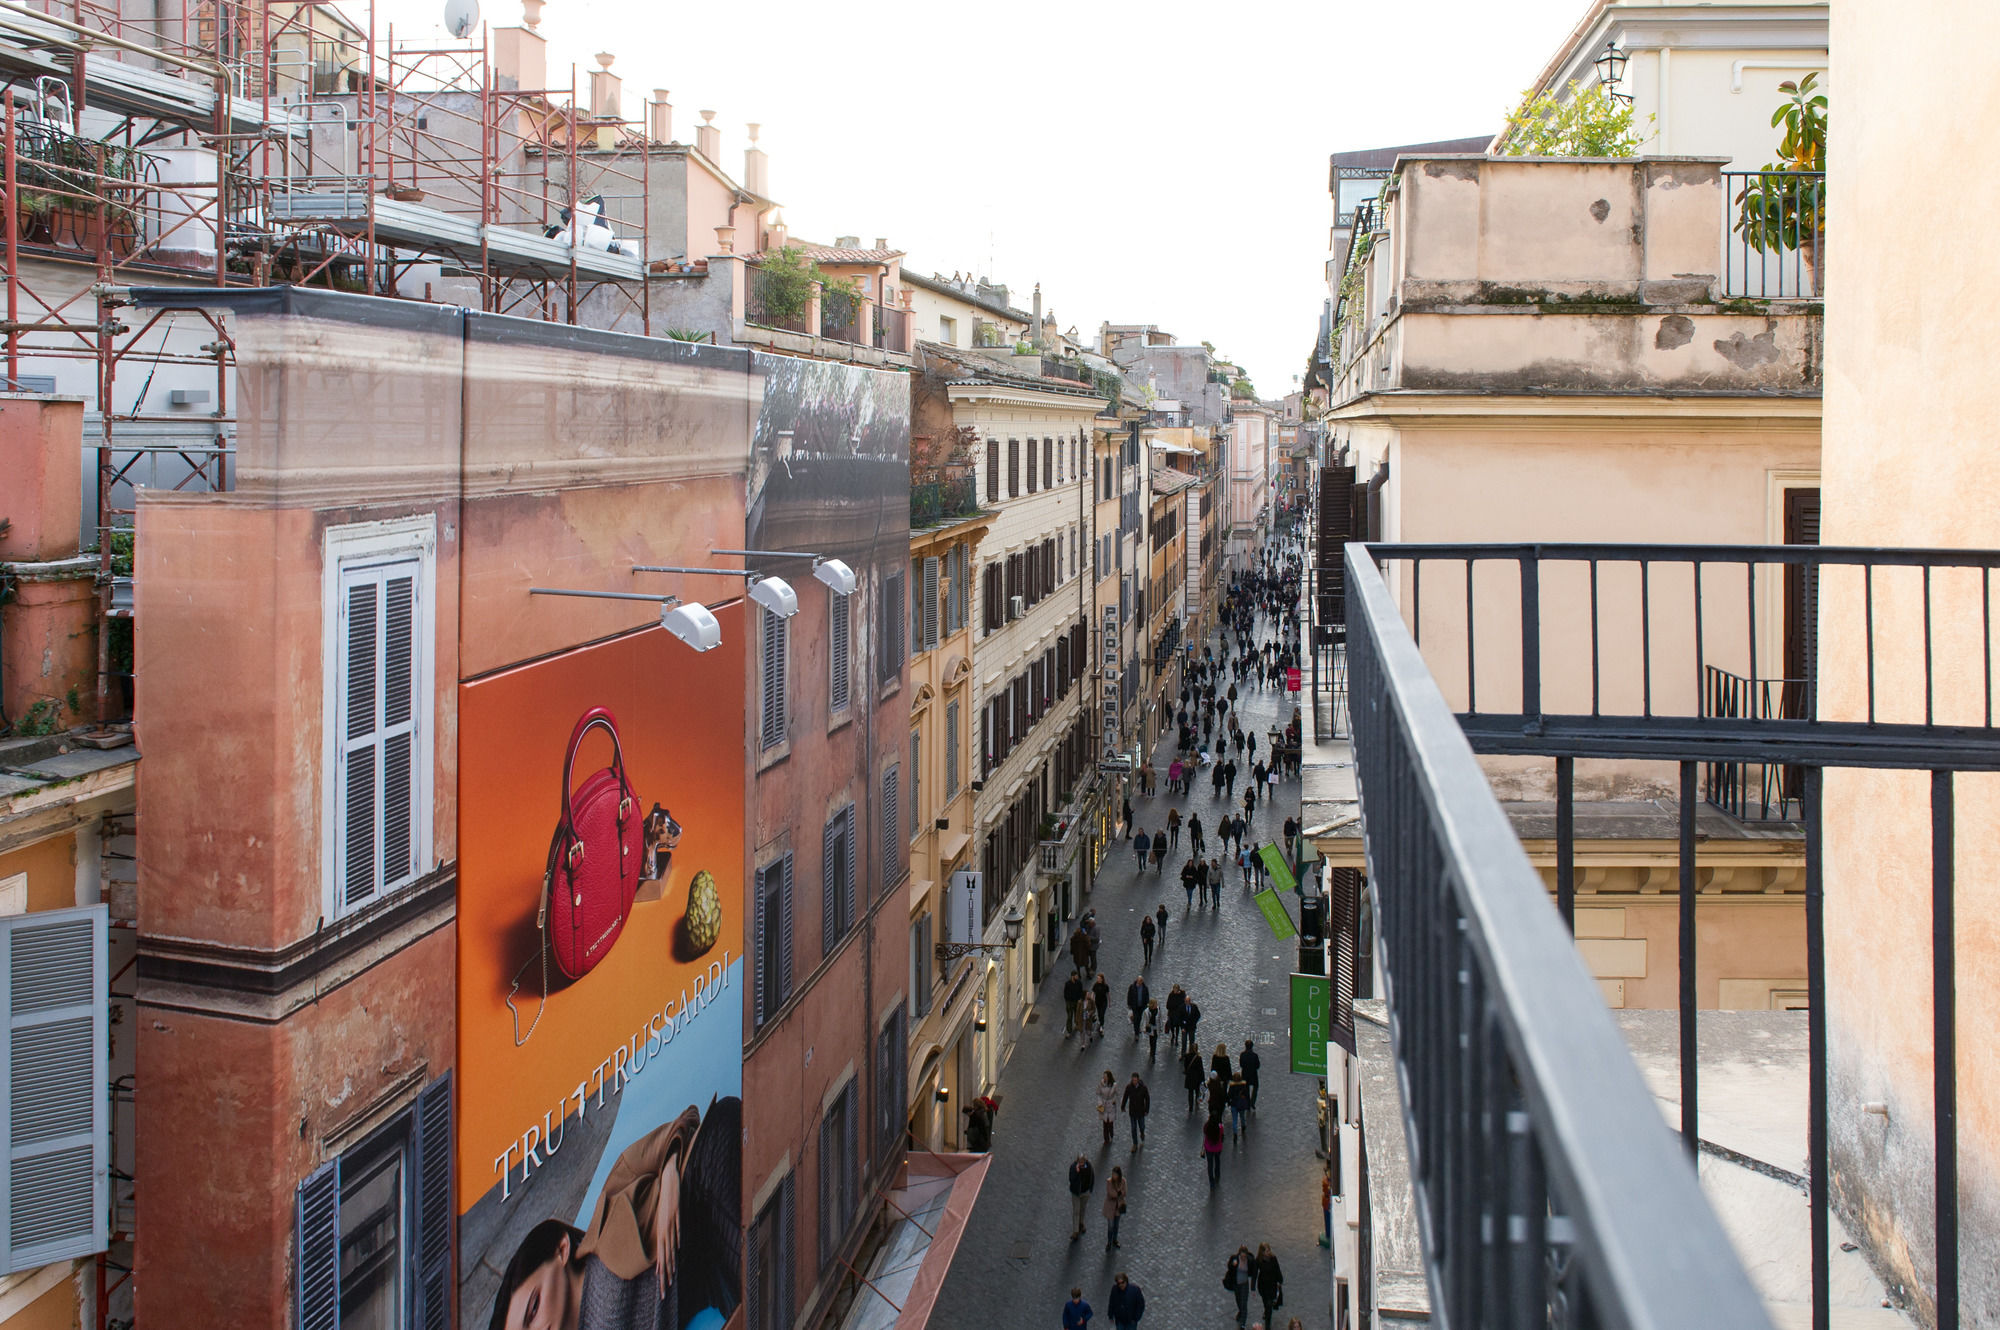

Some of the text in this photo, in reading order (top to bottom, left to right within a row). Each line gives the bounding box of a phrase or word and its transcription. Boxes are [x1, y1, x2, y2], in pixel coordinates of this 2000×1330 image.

[1105, 606, 1116, 758] PROFUMERIA
[494, 951, 730, 1203] TRU TRUSSARDI
[1308, 985, 1320, 1057] PURE
